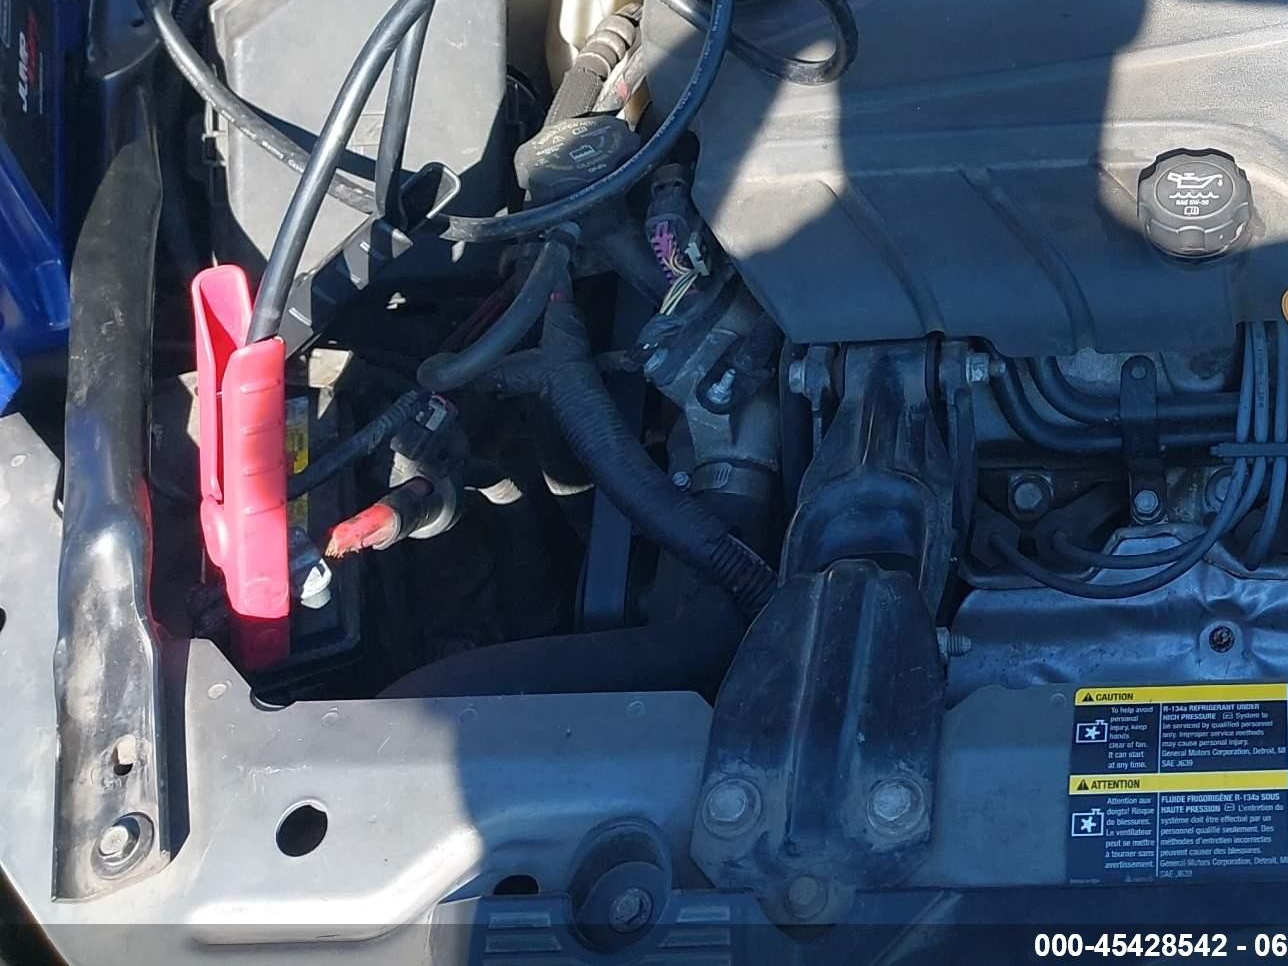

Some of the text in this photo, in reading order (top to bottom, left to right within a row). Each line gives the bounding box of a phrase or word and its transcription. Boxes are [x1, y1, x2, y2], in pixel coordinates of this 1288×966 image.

[1096, 693, 1134, 701] CAUTION
[1110, 715, 1138, 723] personal
[1235, 712, 1259, 720] System
[1202, 721, 1210, 729] by
[1211, 720, 1239, 728] qualified
[1241, 720, 1273, 728] personnel
[1179, 730, 1206, 738] Improper
[1162, 740, 1176, 748] may
[1199, 739, 1227, 747] personal
[1228, 738, 1248, 746] injury.
[1162, 749, 1186, 757] General
[1116, 762, 1129, 770] any
[1162, 760, 1175, 768] SAE
[1091, 780, 1140, 789] ATTENTION
[1161, 793, 1280, 803] FLUIDE R-134a SOUS
[1132, 807, 1155, 815] Risque
[1161, 805, 1220, 814] HAUTE PRESSION
[1190, 815, 1204, 823] doit
[1249, 815, 1261, 823] par
[1116, 828, 1152, 836] ventilateur
[1160, 827, 1193, 835] personnel
[1105, 840, 1121, 848] peut
[1160, 848, 1187, 856] peuvent
[1104, 861, 1154, 869] avertissement.
